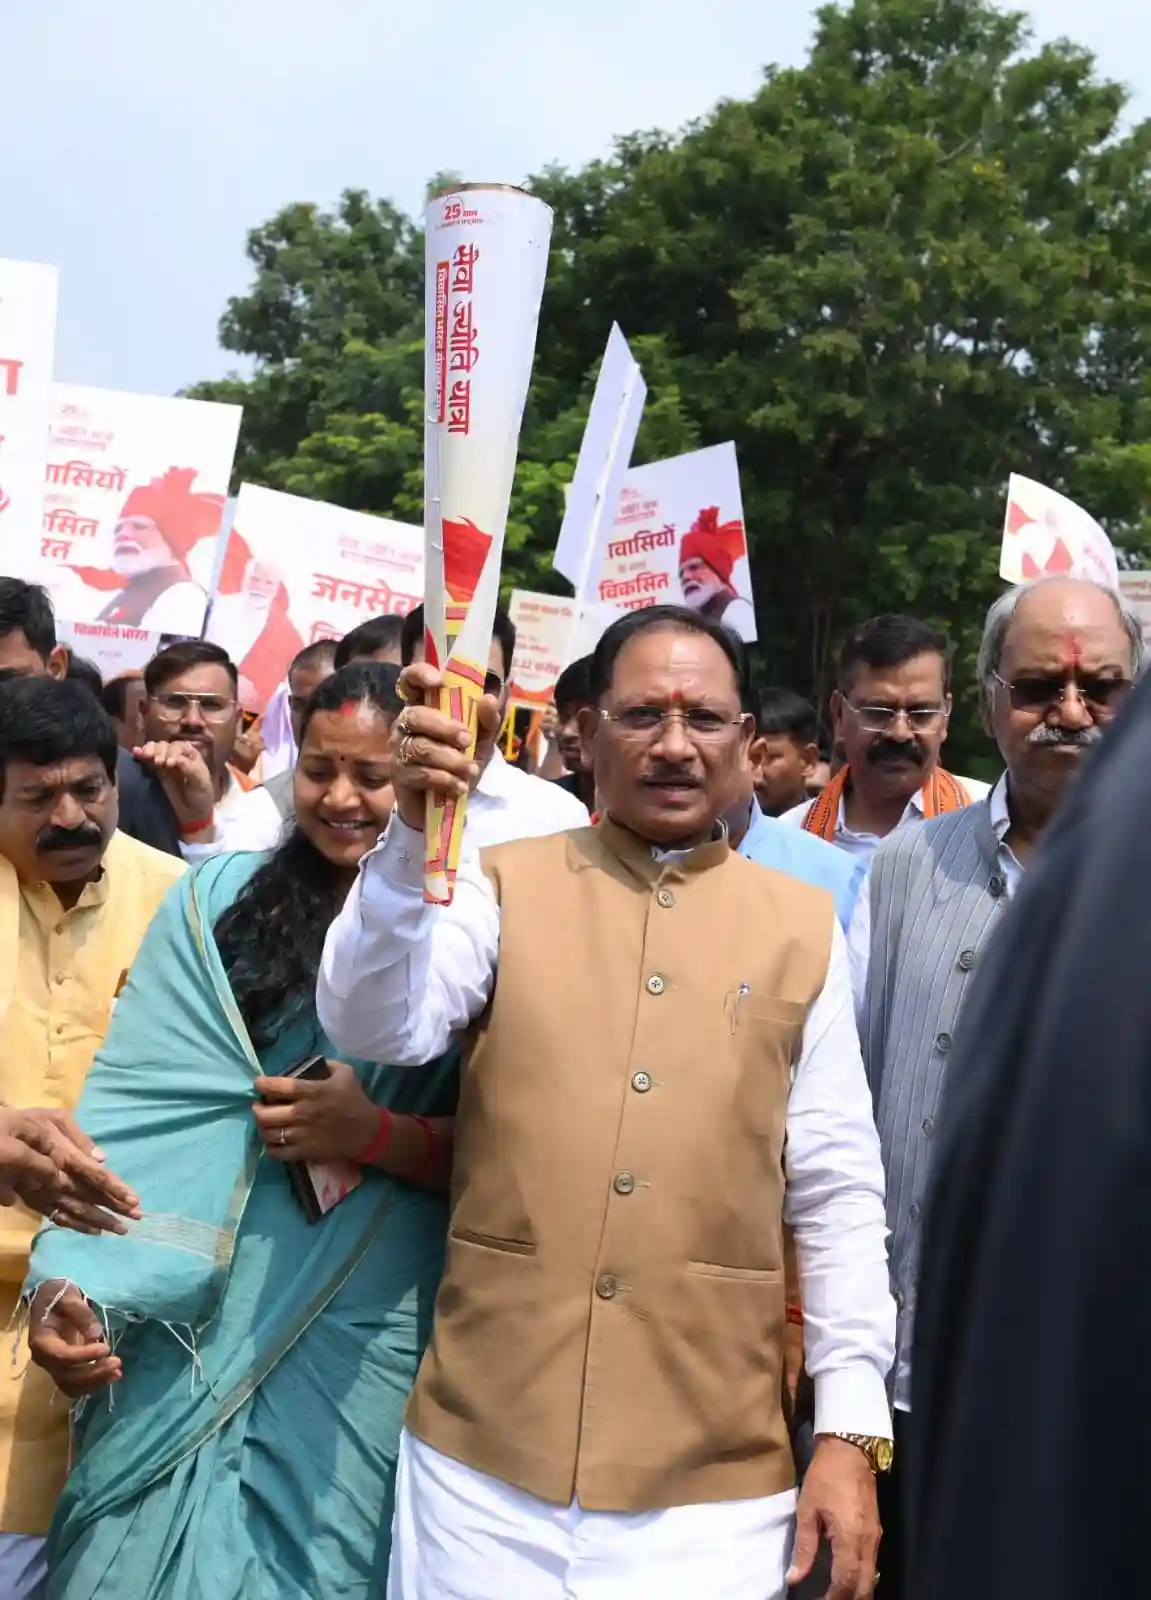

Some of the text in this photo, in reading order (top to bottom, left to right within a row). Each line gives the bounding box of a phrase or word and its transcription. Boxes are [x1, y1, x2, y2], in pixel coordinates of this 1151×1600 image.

[444, 203, 461, 220] 25
[452, 242, 480, 295] सेवा
[449, 300, 480, 373] ज्योति
[448, 379, 471, 436] यात्रा
[45, 461, 130, 492] ासियों
[43, 509, 101, 537] सित
[40, 537, 73, 560] रत
[608, 524, 676, 560] वासियों
[311, 572, 424, 615] जनसेव
[599, 571, 670, 601] विकसित
